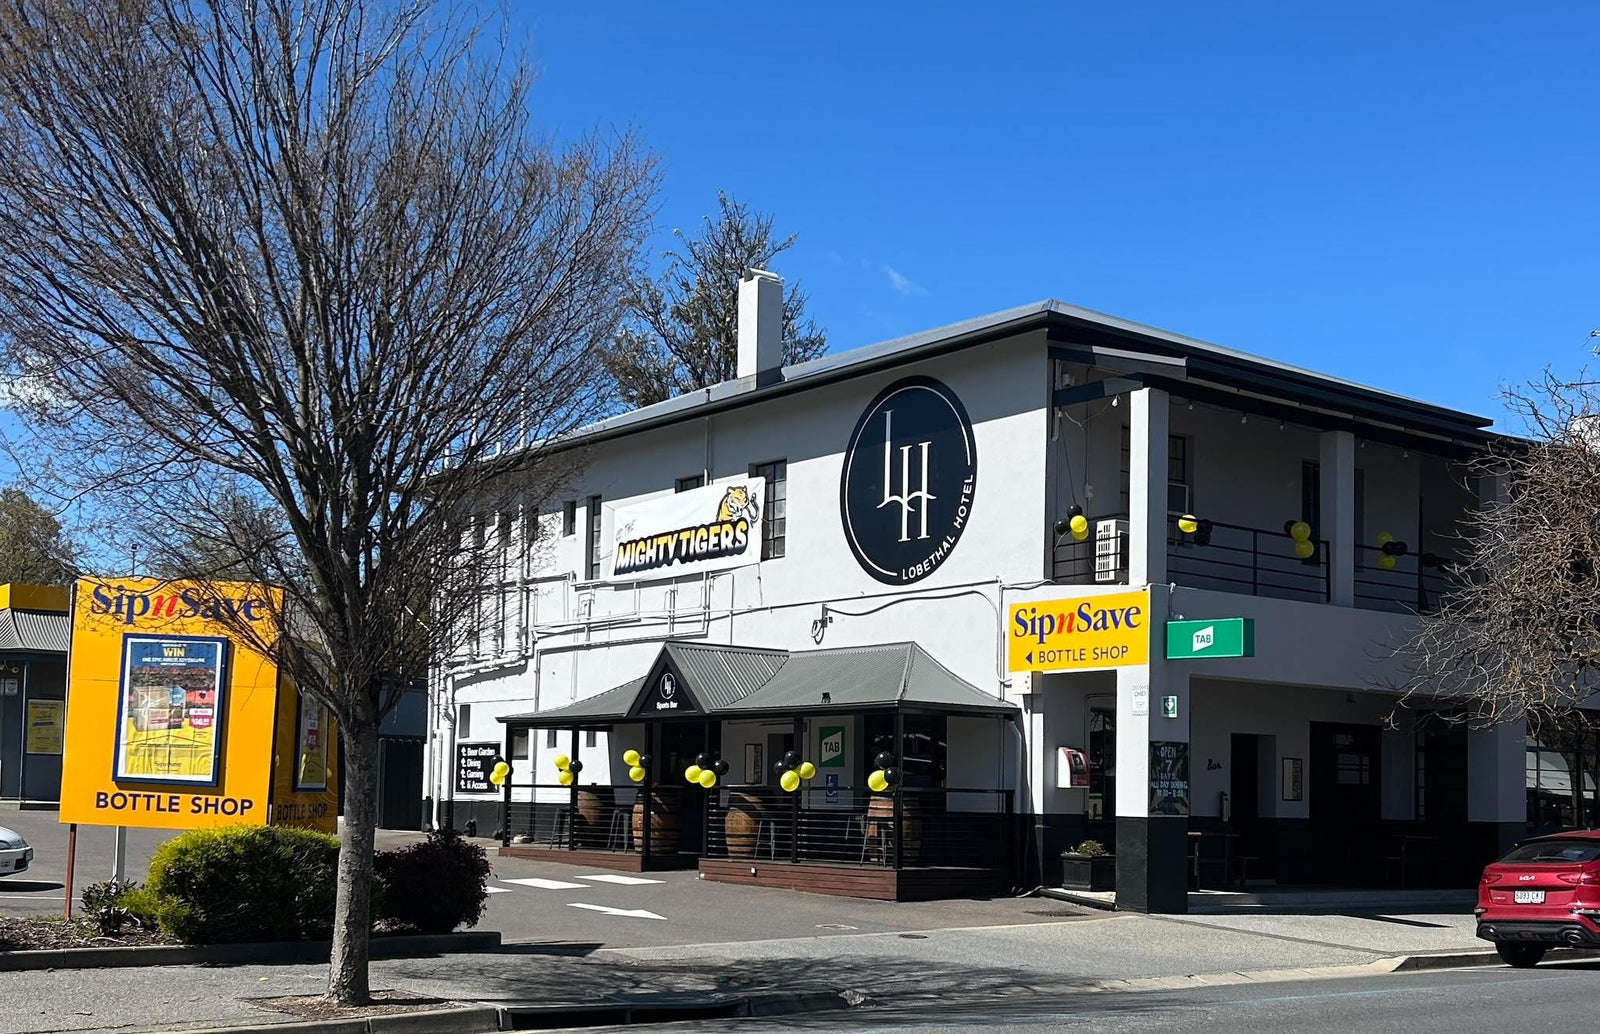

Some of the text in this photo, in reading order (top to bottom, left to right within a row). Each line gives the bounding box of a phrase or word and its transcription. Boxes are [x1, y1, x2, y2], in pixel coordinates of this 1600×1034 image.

[902, 474, 974, 580] LOBETHAL HOTEL
[616, 532, 679, 570] MIGHTY
[680, 520, 748, 558] TIGERS
[1195, 634, 1211, 644] TAB
[163, 647, 185, 657] WIN
[1038, 645, 1129, 663] BOTTLE SHOP
[478, 747, 496, 756] Garden
[824, 742, 840, 753] TAB
[1160, 746, 1176, 758] OPEN
[1165, 760, 1173, 772] 7
[471, 781, 488, 789] Access
[95, 791, 254, 816] BOTTLE SHOP
[276, 802, 328, 821] BOTTLE SHOP
